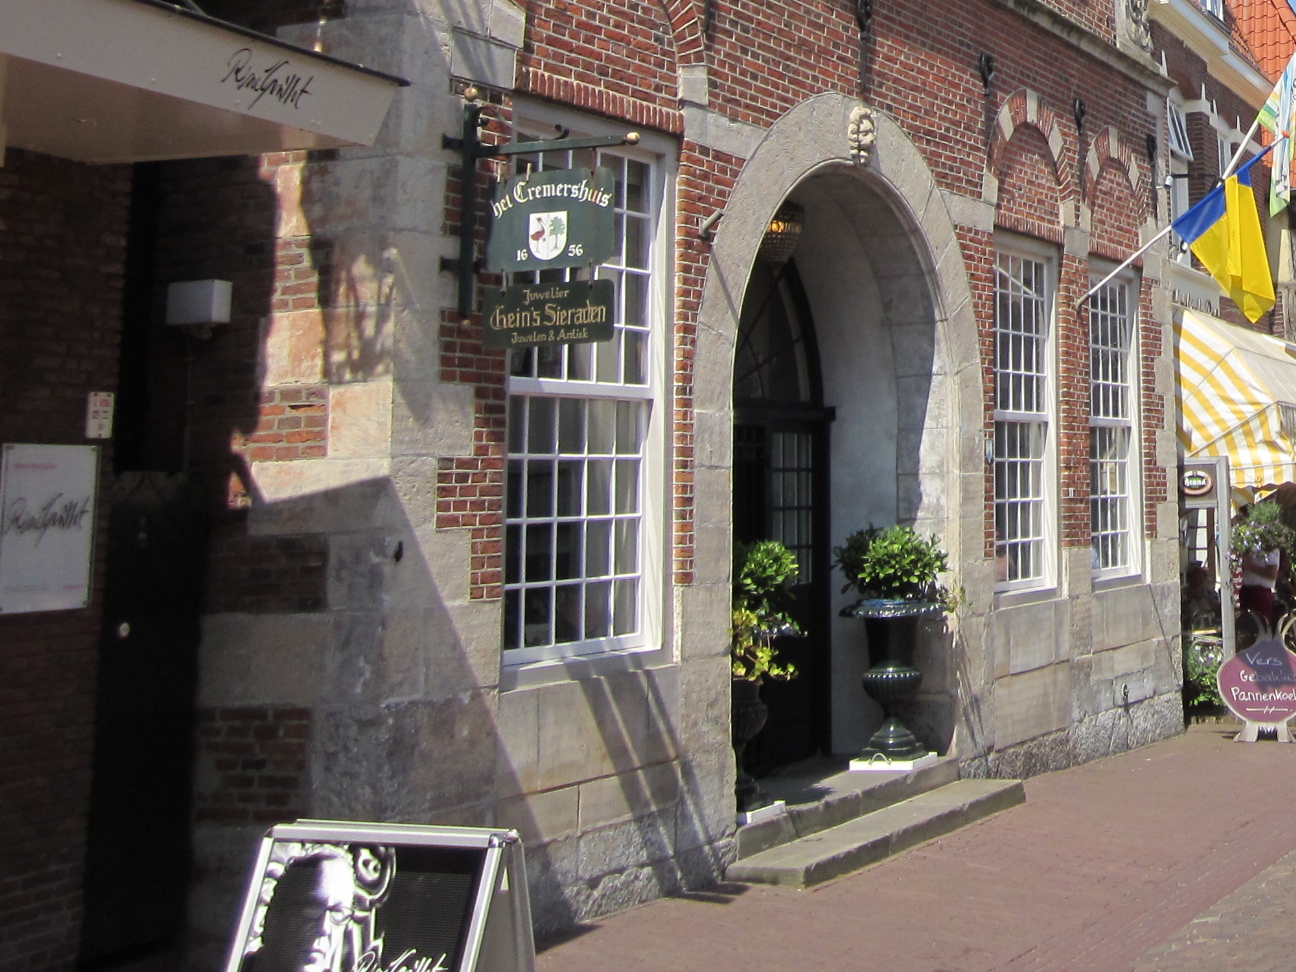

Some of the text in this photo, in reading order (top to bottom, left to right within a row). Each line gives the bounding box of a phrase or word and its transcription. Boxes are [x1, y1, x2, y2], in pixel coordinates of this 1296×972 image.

[513, 179, 612, 207] Cremershuis
[516, 244, 583, 261] 16 56
[523, 288, 569, 305] Juwelier
[543, 299, 606, 326] Sieraden
[511, 328, 588, 344] Juwelen & Antiek
[1245, 651, 1283, 666] Vers
